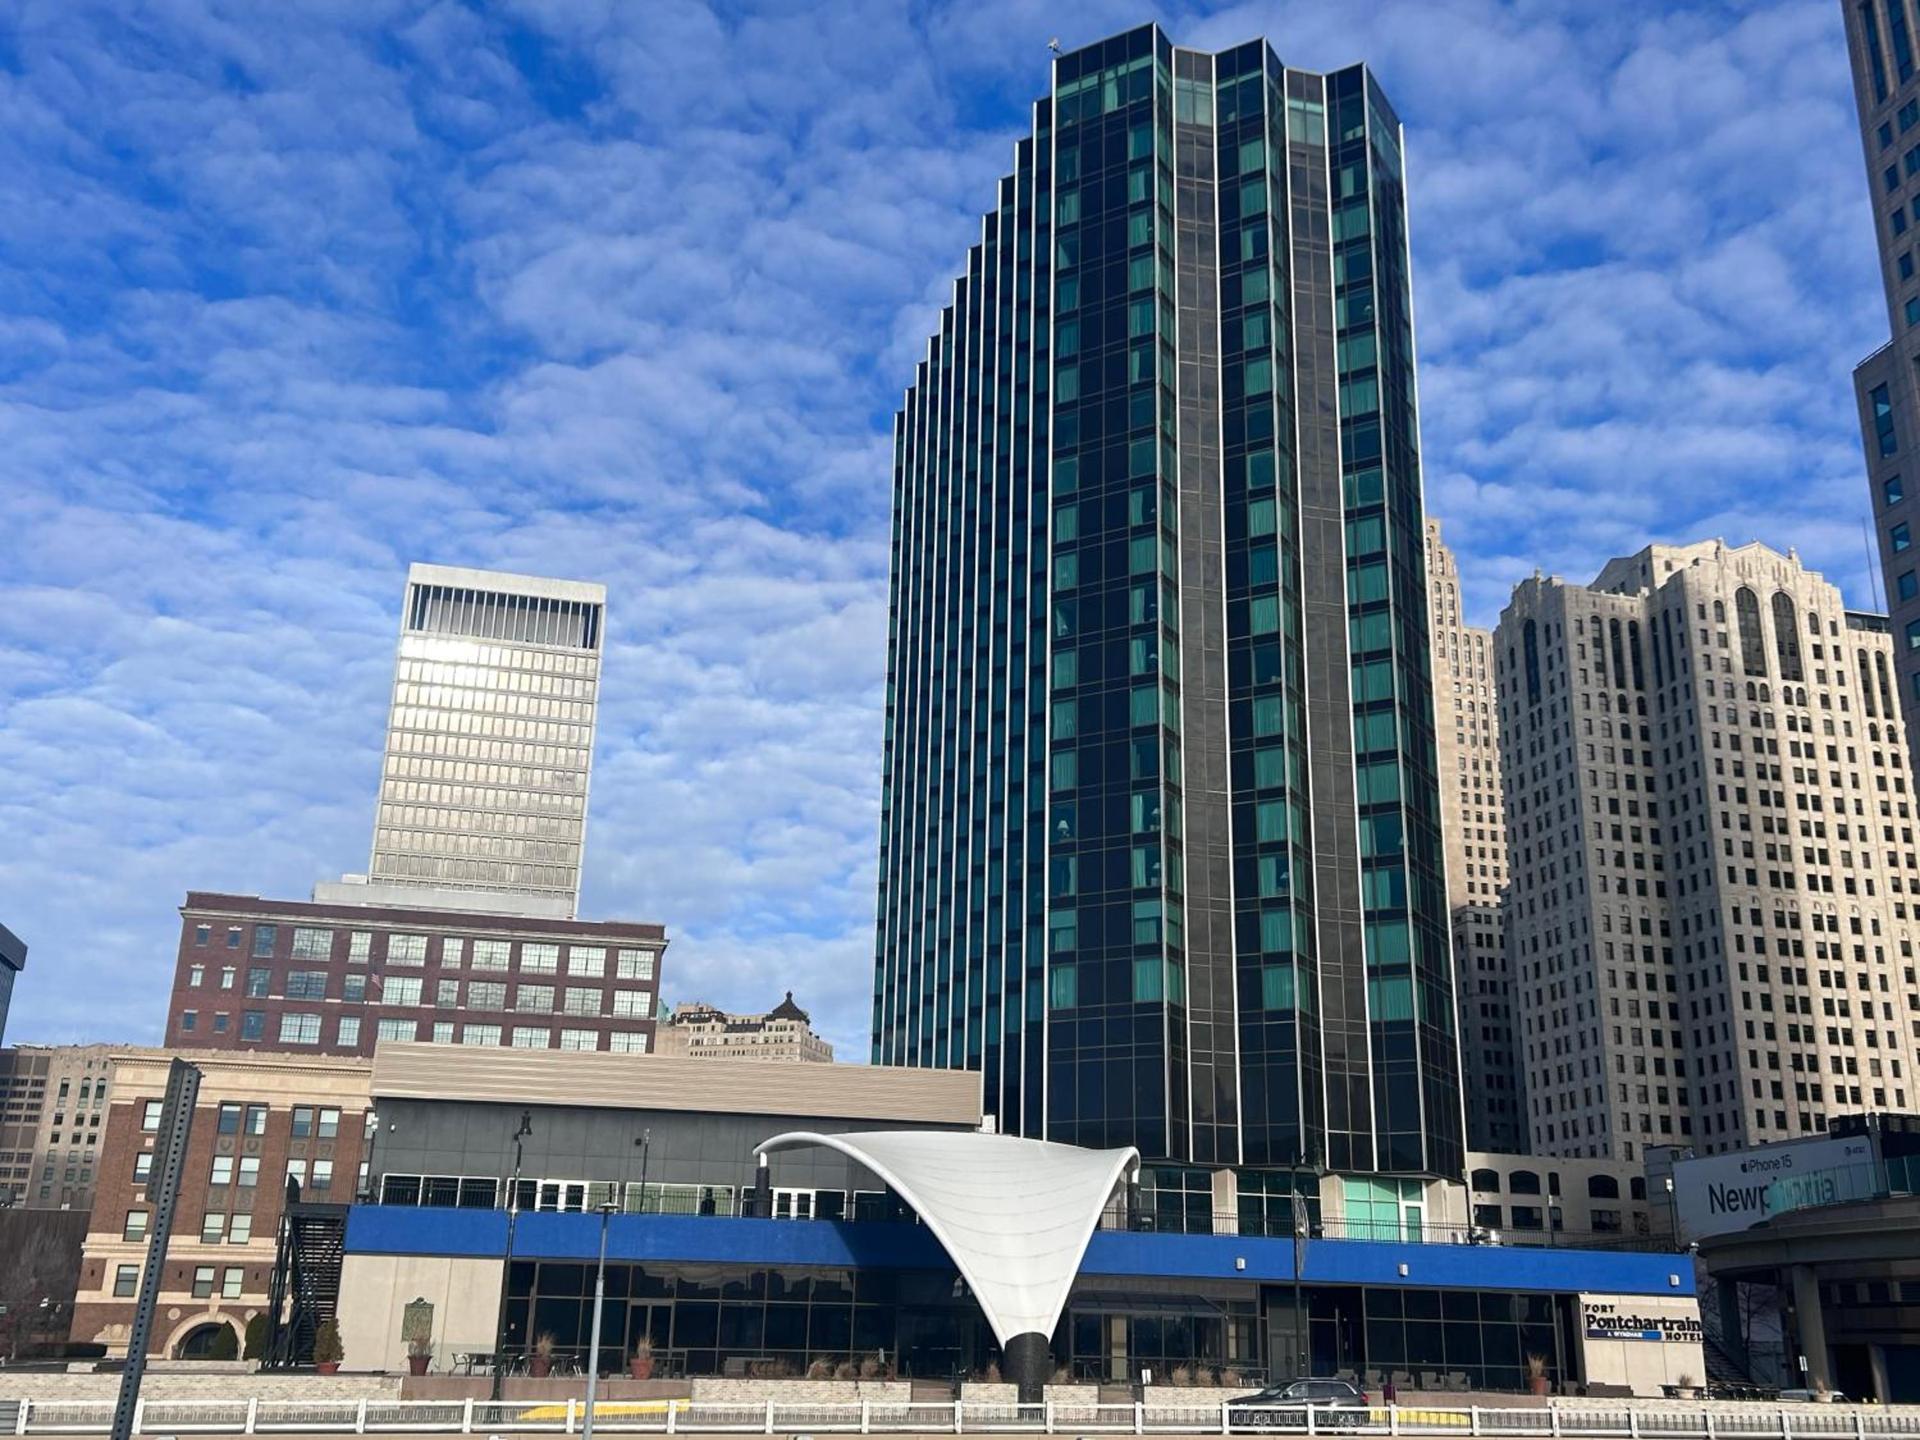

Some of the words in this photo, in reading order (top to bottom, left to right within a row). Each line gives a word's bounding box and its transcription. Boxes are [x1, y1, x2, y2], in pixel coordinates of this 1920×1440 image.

[1748, 1158, 1780, 1173] iPhone
[1782, 1154, 1793, 1168] 15
[1708, 1171, 1834, 1216] Newporia
[1584, 1304, 1615, 1313] FORT
[1586, 1314, 1702, 1331] Pontchartrain
[1665, 1332, 1703, 1341] HOTEL
